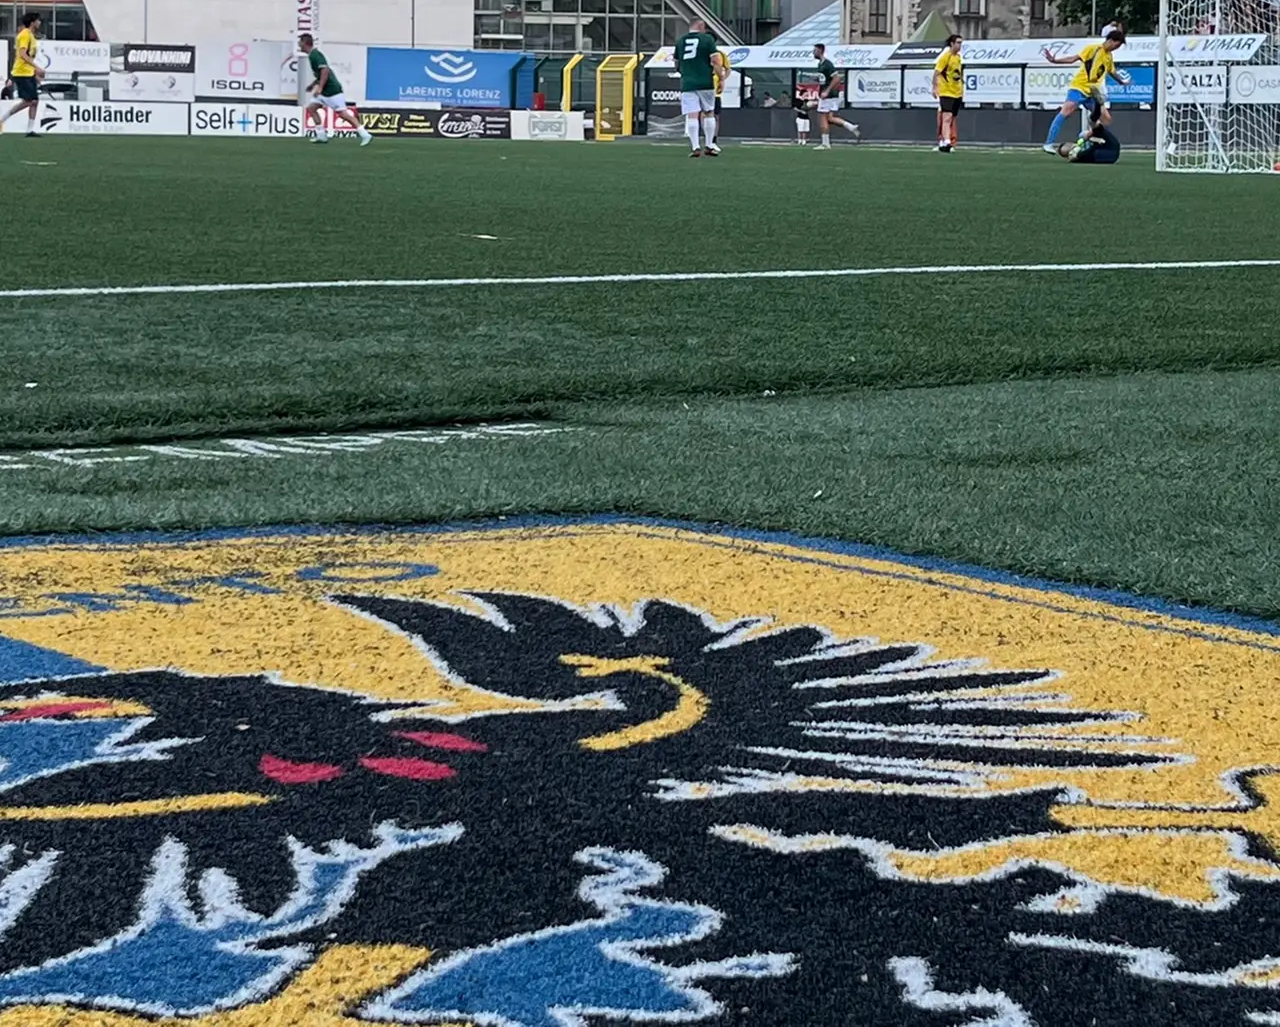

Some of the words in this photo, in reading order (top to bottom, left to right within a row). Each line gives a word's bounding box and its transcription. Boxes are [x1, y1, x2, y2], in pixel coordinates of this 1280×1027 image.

[683, 38, 700, 60] 3
[1202, 37, 1257, 51] VIMAR
[962, 48, 1016, 60] COMAI
[211, 79, 265, 91] ISOLA
[978, 75, 1020, 87] GIACCA
[399, 86, 453, 98] LARENTIS
[457, 88, 501, 99] LORENZ
[1126, 84, 1154, 94] LORENZ
[70, 104, 152, 123] Holländer
